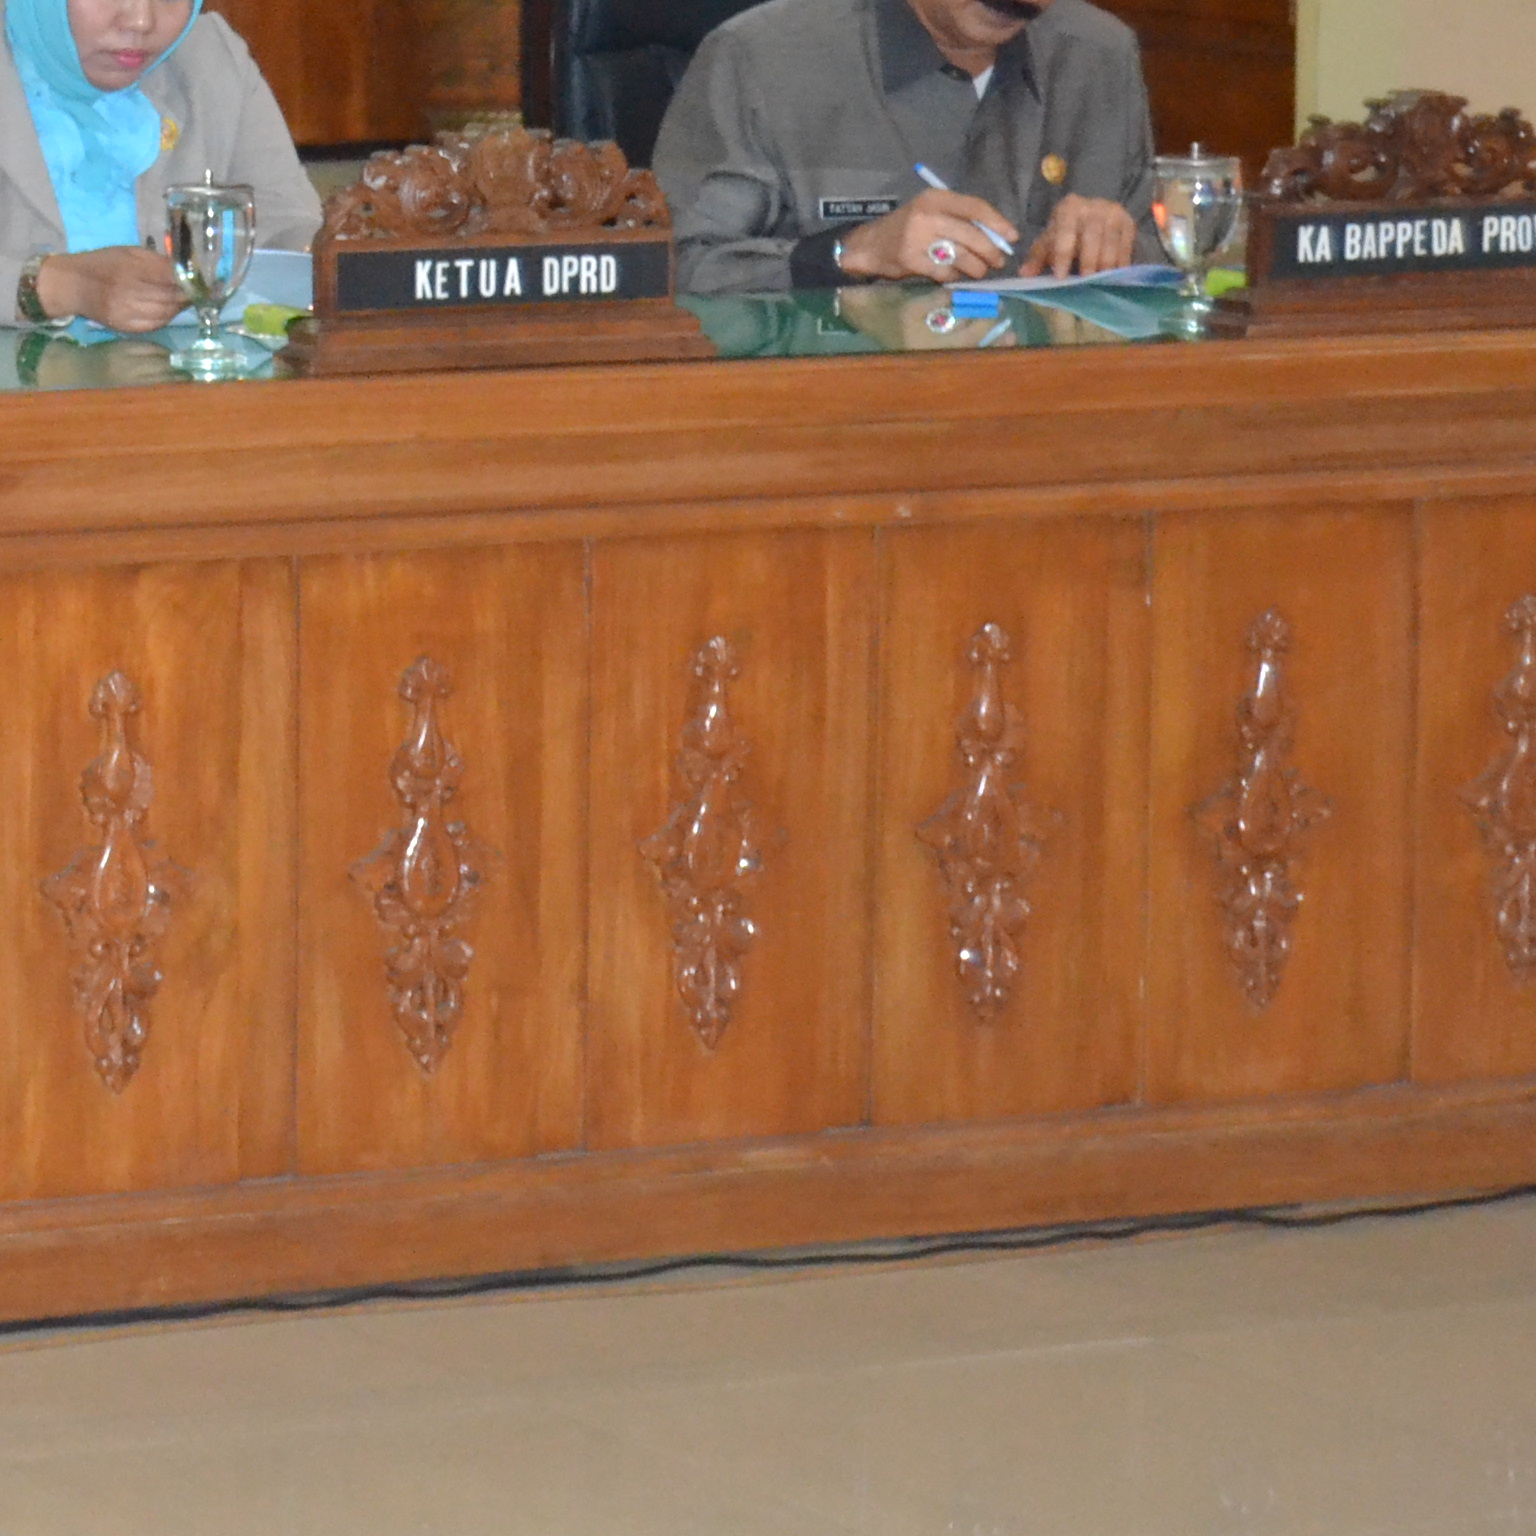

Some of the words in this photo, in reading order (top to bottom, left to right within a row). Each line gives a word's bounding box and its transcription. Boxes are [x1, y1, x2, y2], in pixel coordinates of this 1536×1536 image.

[1297, 224, 1333, 263] KA
[1343, 217, 1465, 261] BAPPEDA
[1481, 214, 1536, 253] PRO
[414, 257, 522, 300] KETUA
[541, 253, 618, 297] DPRD
